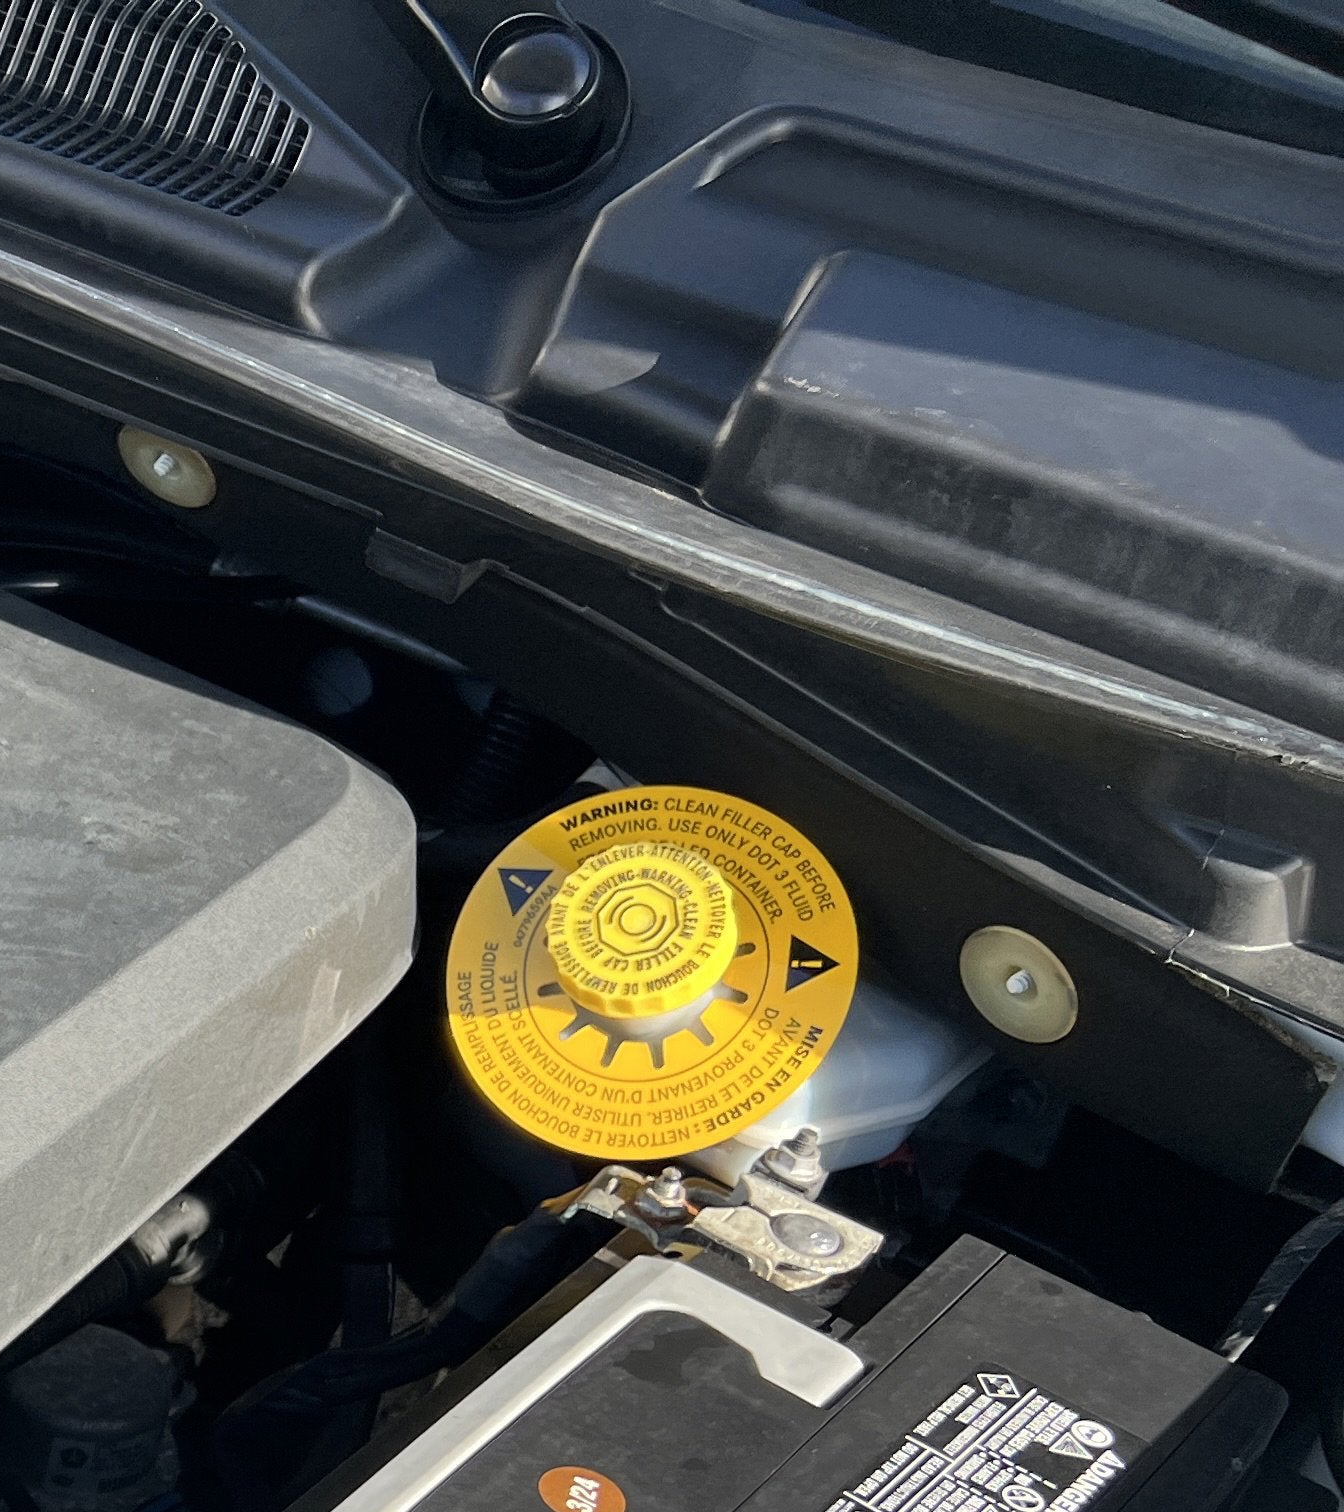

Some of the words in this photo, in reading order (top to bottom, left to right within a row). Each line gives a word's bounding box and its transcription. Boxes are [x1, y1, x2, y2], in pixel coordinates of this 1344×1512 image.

[559, 799, 659, 832] WARNING:
[664, 798, 719, 818] CLEAN
[721, 807, 773, 841] FILLER
[771, 836, 801, 859] CAP
[799, 857, 836, 913] BEFORE
[569, 817, 662, 851] REMOVING.
[668, 818, 702, 834] USE
[705, 823, 750, 850] ONLY
[747, 846, 780, 872] DOT
[774, 870, 790, 881] 3
[786, 881, 813, 923] FLUID
[713, 854, 783, 924] CONTAINER.
[577, 919, 604, 959] BEFORE
[480, 941, 499, 1001] LIQUIDE
[604, 955, 630, 972] CAP
[635, 942, 683, 972] FILLER
[485, 1004, 501, 1030] DU
[500, 970, 526, 1032] SCELLÉ.
[457, 971, 497, 1073] REMPLISSAGE
[757, 1007, 780, 1040] DOT
[742, 1039, 756, 1051] 3
[762, 1017, 801, 1068] AVANT
[786, 1025, 824, 1070] MISE
[491, 1040, 570, 1111] UNIQUEMENT
[519, 1032, 597, 1097] CONTENANT
[648, 1052, 745, 1103] PROVENANT
[744, 1070, 763, 1088] DE
[765, 1068, 792, 1093] EN
[490, 1072, 512, 1094] DE
[601, 1087, 642, 1104] D'UN
[721, 1085, 742, 1101] LE
[509, 1089, 578, 1139] BOUCHON
[573, 1102, 642, 1127] UTILISER
[648, 1093, 718, 1124] RETIRER.
[582, 1127, 602, 1145] LE
[606, 1128, 690, 1148] NETTOYER
